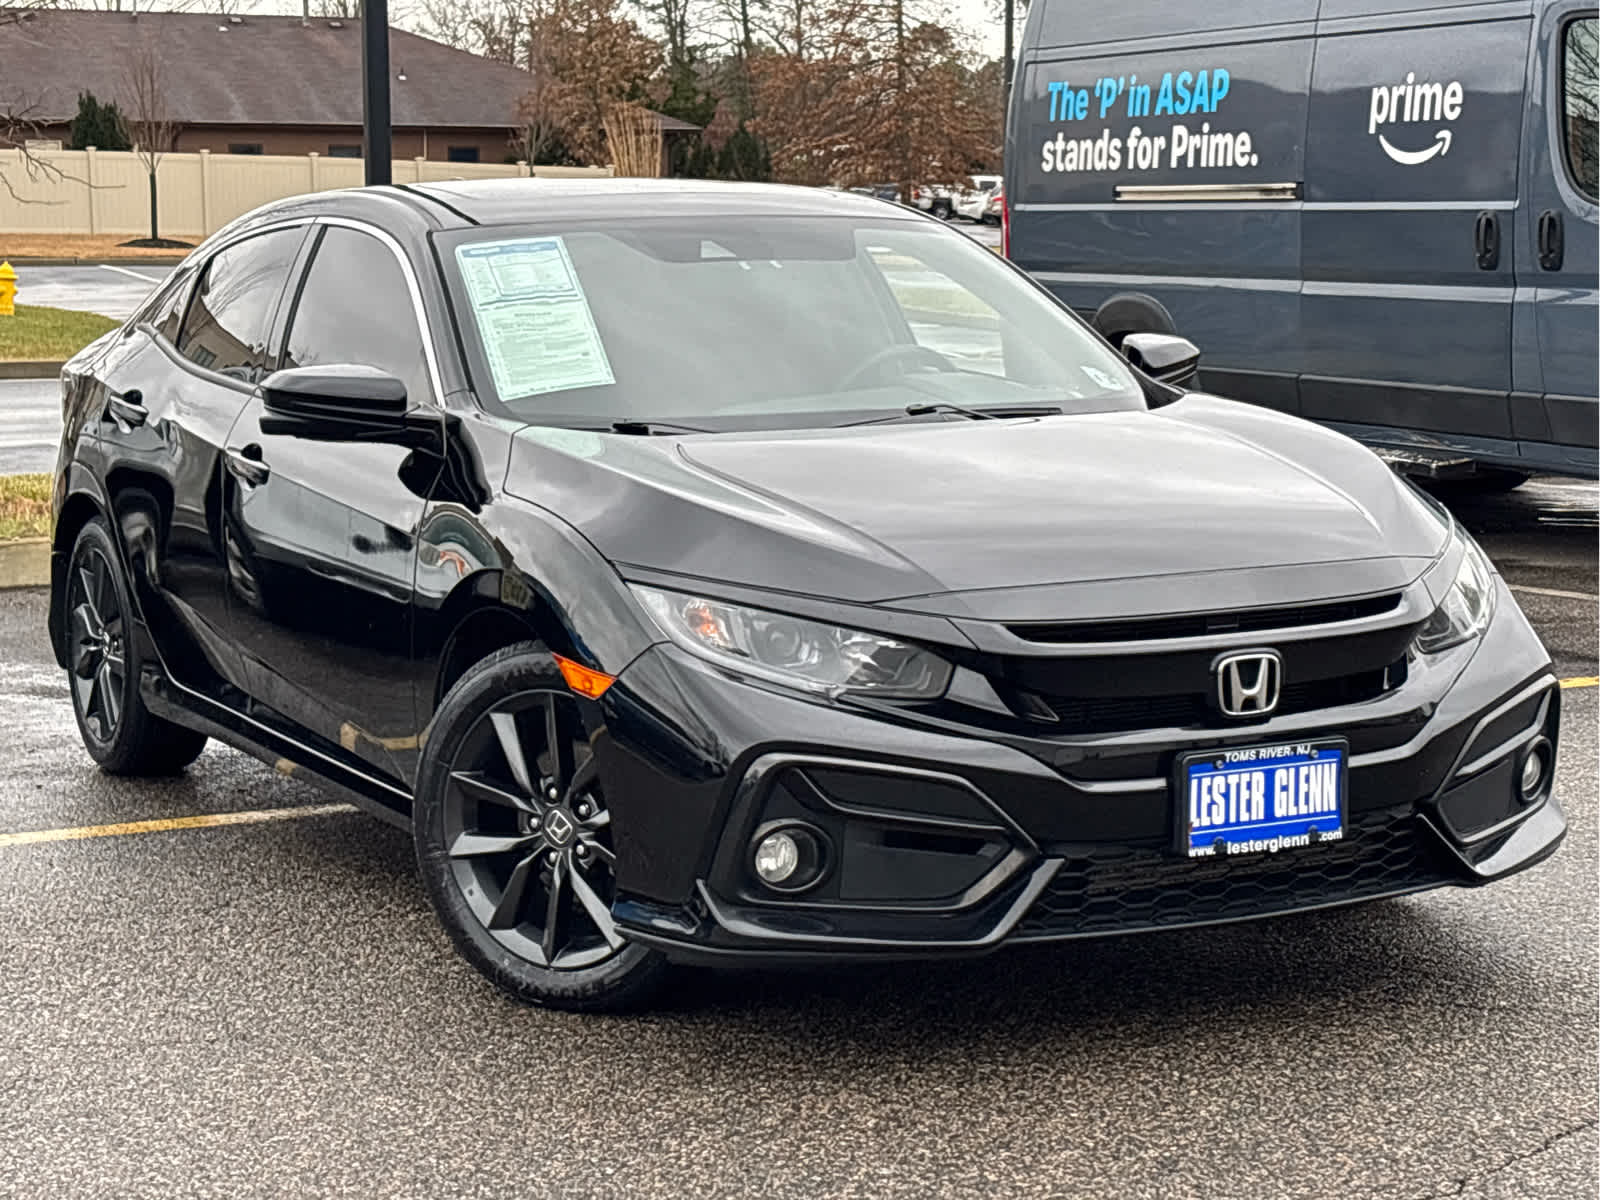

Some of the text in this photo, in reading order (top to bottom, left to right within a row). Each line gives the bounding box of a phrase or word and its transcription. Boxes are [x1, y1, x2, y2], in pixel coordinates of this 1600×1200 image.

[1048, 81, 1088, 122] The
[1129, 76, 1149, 118] in
[1156, 68, 1230, 116] ASAP
[1369, 72, 1464, 134] prime
[1041, 122, 1259, 173] stands for Prime.
[1224, 750, 1256, 763] TOMS
[1296, 743, 1311, 756] NJ
[1190, 763, 1338, 828] LESTER GLENN
